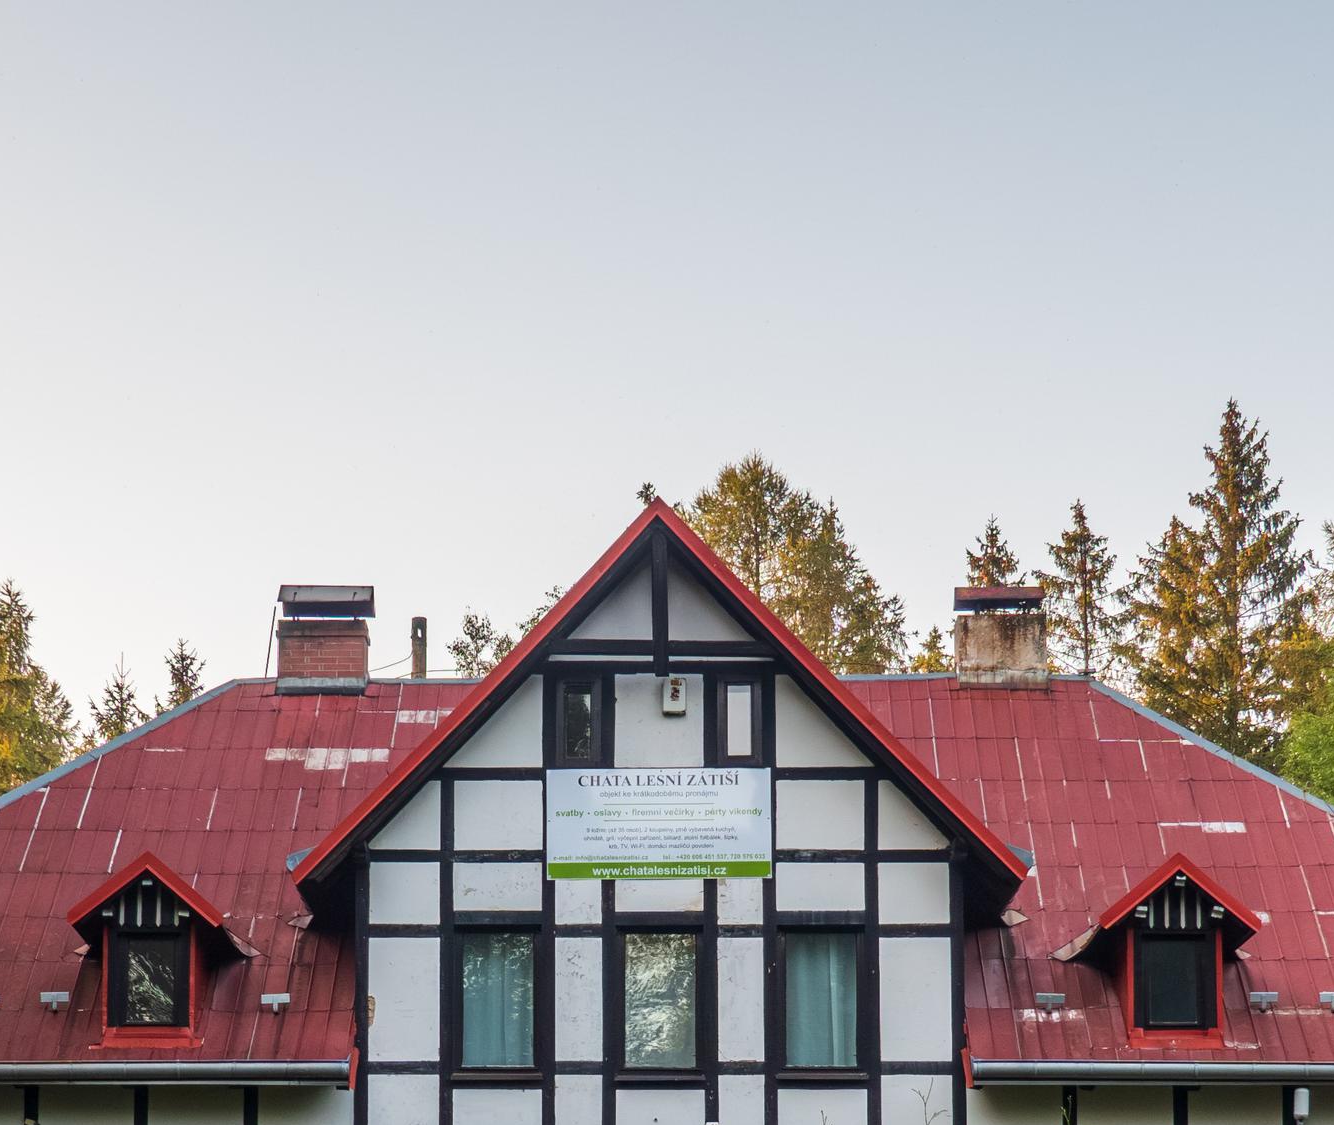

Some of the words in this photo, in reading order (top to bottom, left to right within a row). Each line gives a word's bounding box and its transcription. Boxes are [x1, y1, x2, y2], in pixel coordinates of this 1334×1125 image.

[578, 774, 632, 788] CHATA
[636, 771, 682, 787] LESNÍ
[686, 770, 740, 786] ZÁTIŠÍ
[599, 790, 622, 799] objekt
[623, 790, 632, 798] ke
[685, 789, 719, 798] pronájmu
[555, 808, 584, 818] svatby
[593, 808, 622, 818] oslavy
[632, 808, 661, 816] firemní
[592, 864, 727, 876] www.chatalesnizatisi.cz
